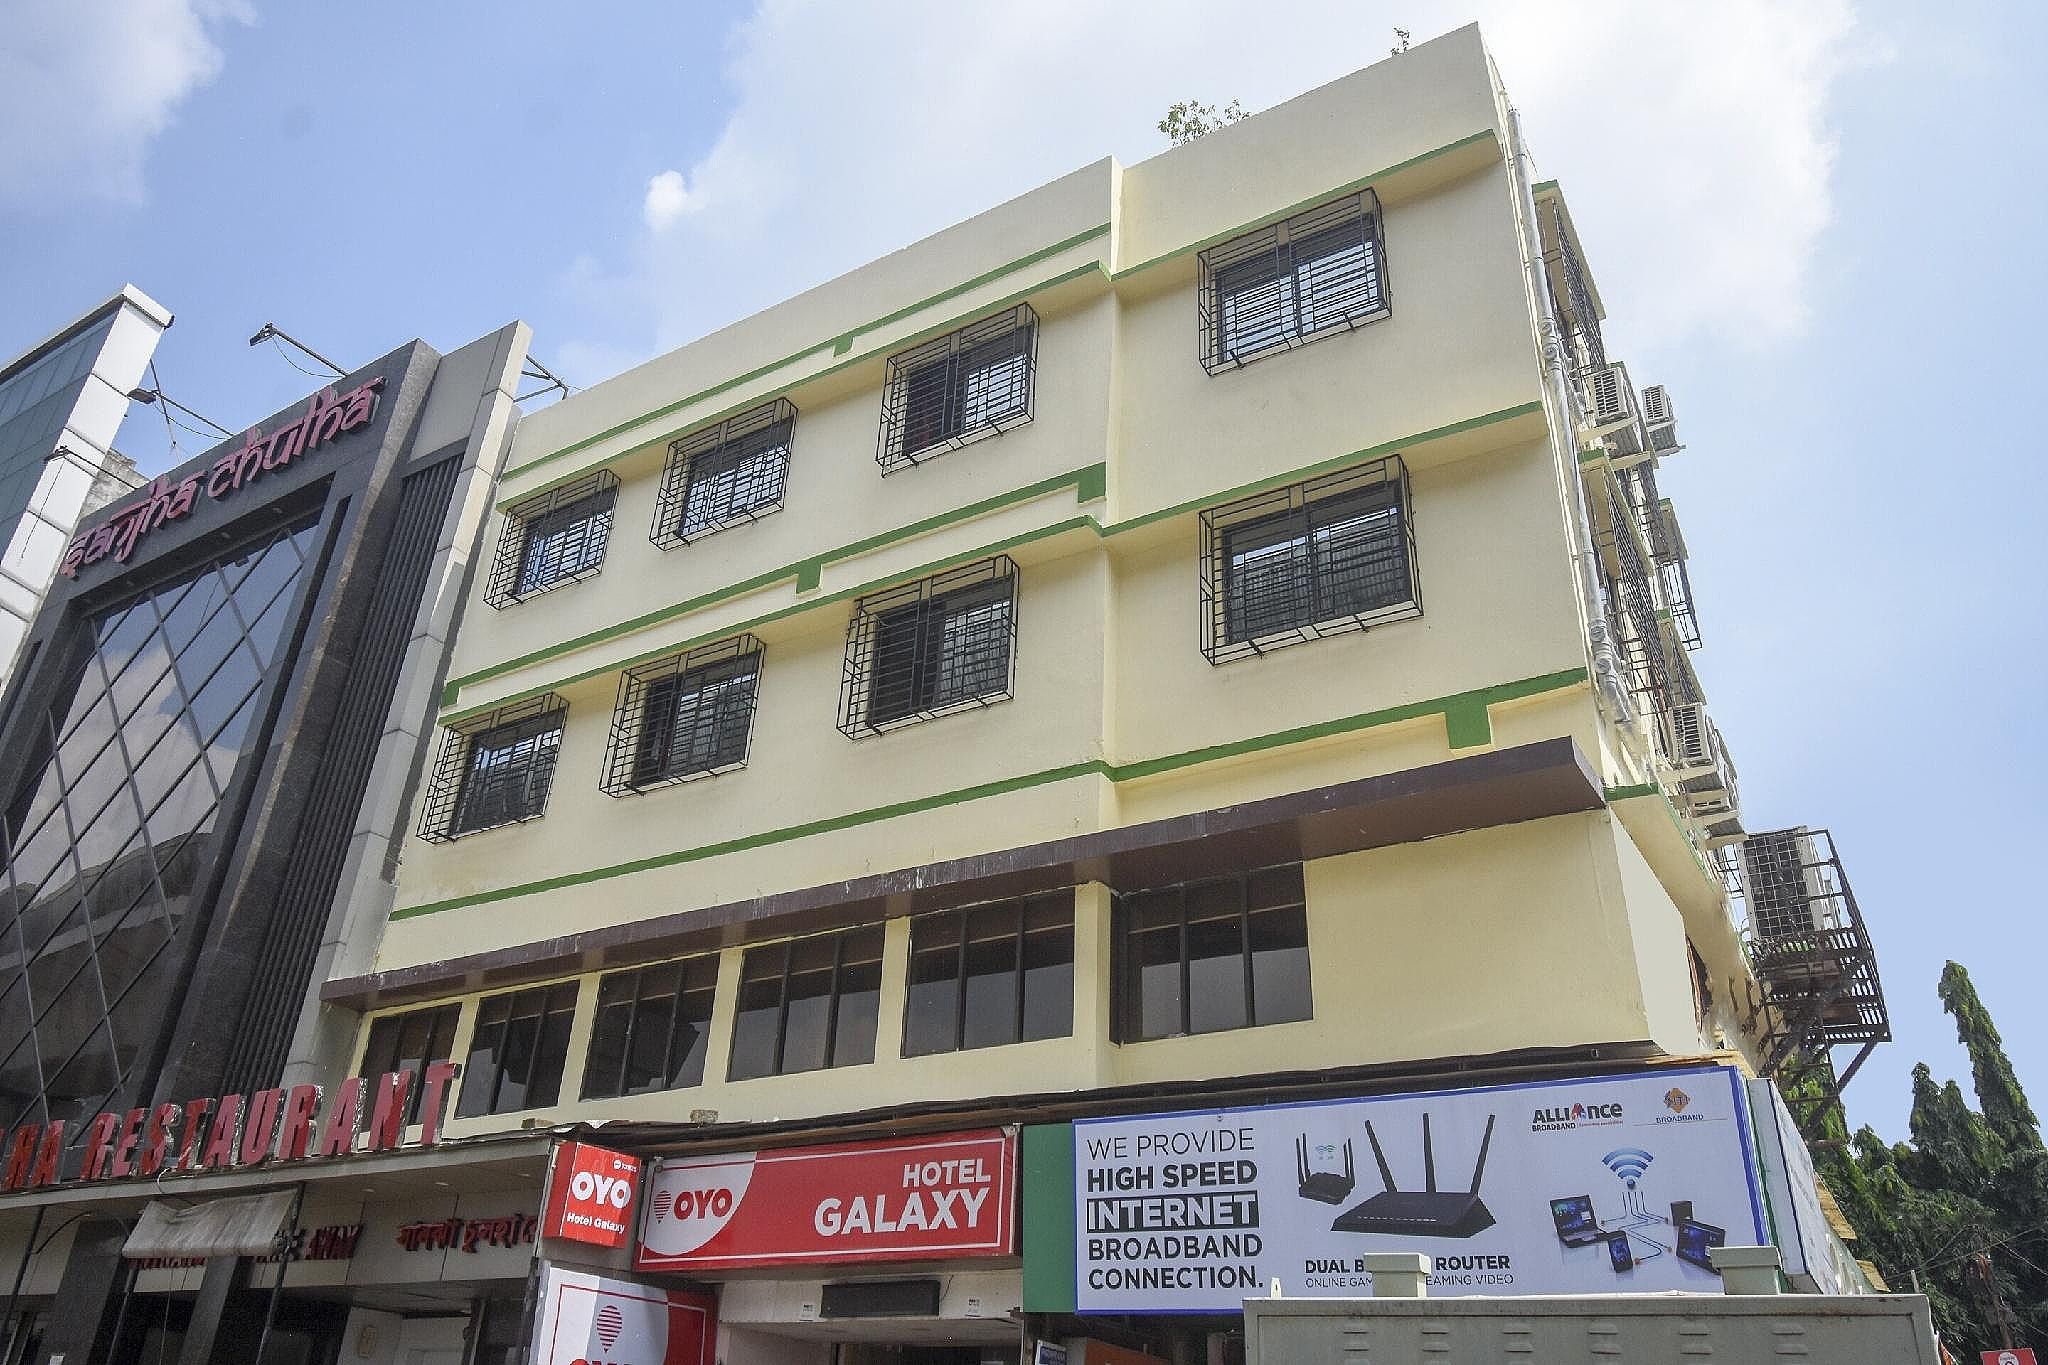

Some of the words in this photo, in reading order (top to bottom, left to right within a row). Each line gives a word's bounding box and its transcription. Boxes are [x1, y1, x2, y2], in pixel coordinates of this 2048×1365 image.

[80, 1062, 461, 1182] RESTAURANT
[1531, 1122, 1577, 1132] BROADBAND
[1655, 1113, 1704, 1125] BROADBAND
[1087, 1137, 1128, 1161] WE
[1137, 1127, 1255, 1157] PROVIDE
[902, 1158, 991, 1188] HOTEL
[1087, 1165, 1154, 1192] HIGH
[1162, 1159, 1258, 1188] SPEED
[571, 1171, 631, 1209] OYO
[673, 1188, 733, 1221] OYO
[566, 1212, 592, 1227] Hotel
[594, 1216, 625, 1234] Galaxy
[814, 1187, 990, 1237] GALAXY
[1087, 1193, 1257, 1231] INTERNET
[1088, 1233, 1263, 1261] BROADBAND
[1088, 1265, 1264, 1290] CONNECTION.
[1305, 1259, 1351, 1274] DUAL
[1435, 1255, 1510, 1271] ROUTER
[1305, 1277, 1347, 1288] ONLINE
[1475, 1273, 1514, 1286] VIDEO
